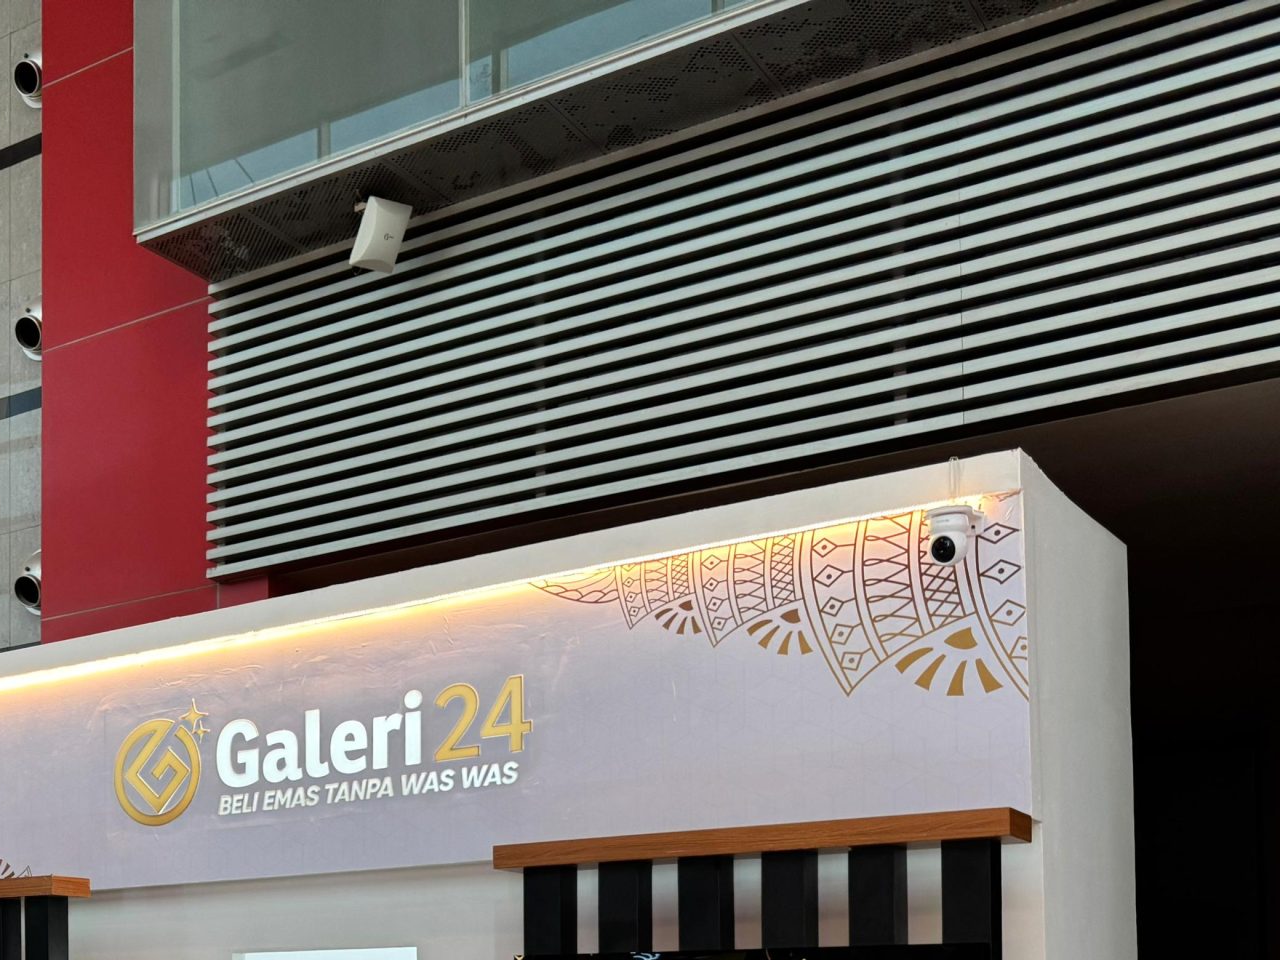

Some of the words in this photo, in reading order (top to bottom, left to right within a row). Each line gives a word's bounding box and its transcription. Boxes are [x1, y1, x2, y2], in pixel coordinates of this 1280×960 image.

[216, 690, 422, 787] Galeri
[433, 674, 533, 762] 24
[218, 792, 259, 815] BELI
[263, 786, 320, 810] EMAS
[325, 777, 393, 804] TANPA
[401, 769, 455, 796] WAS
[461, 761, 519, 788] WAS
